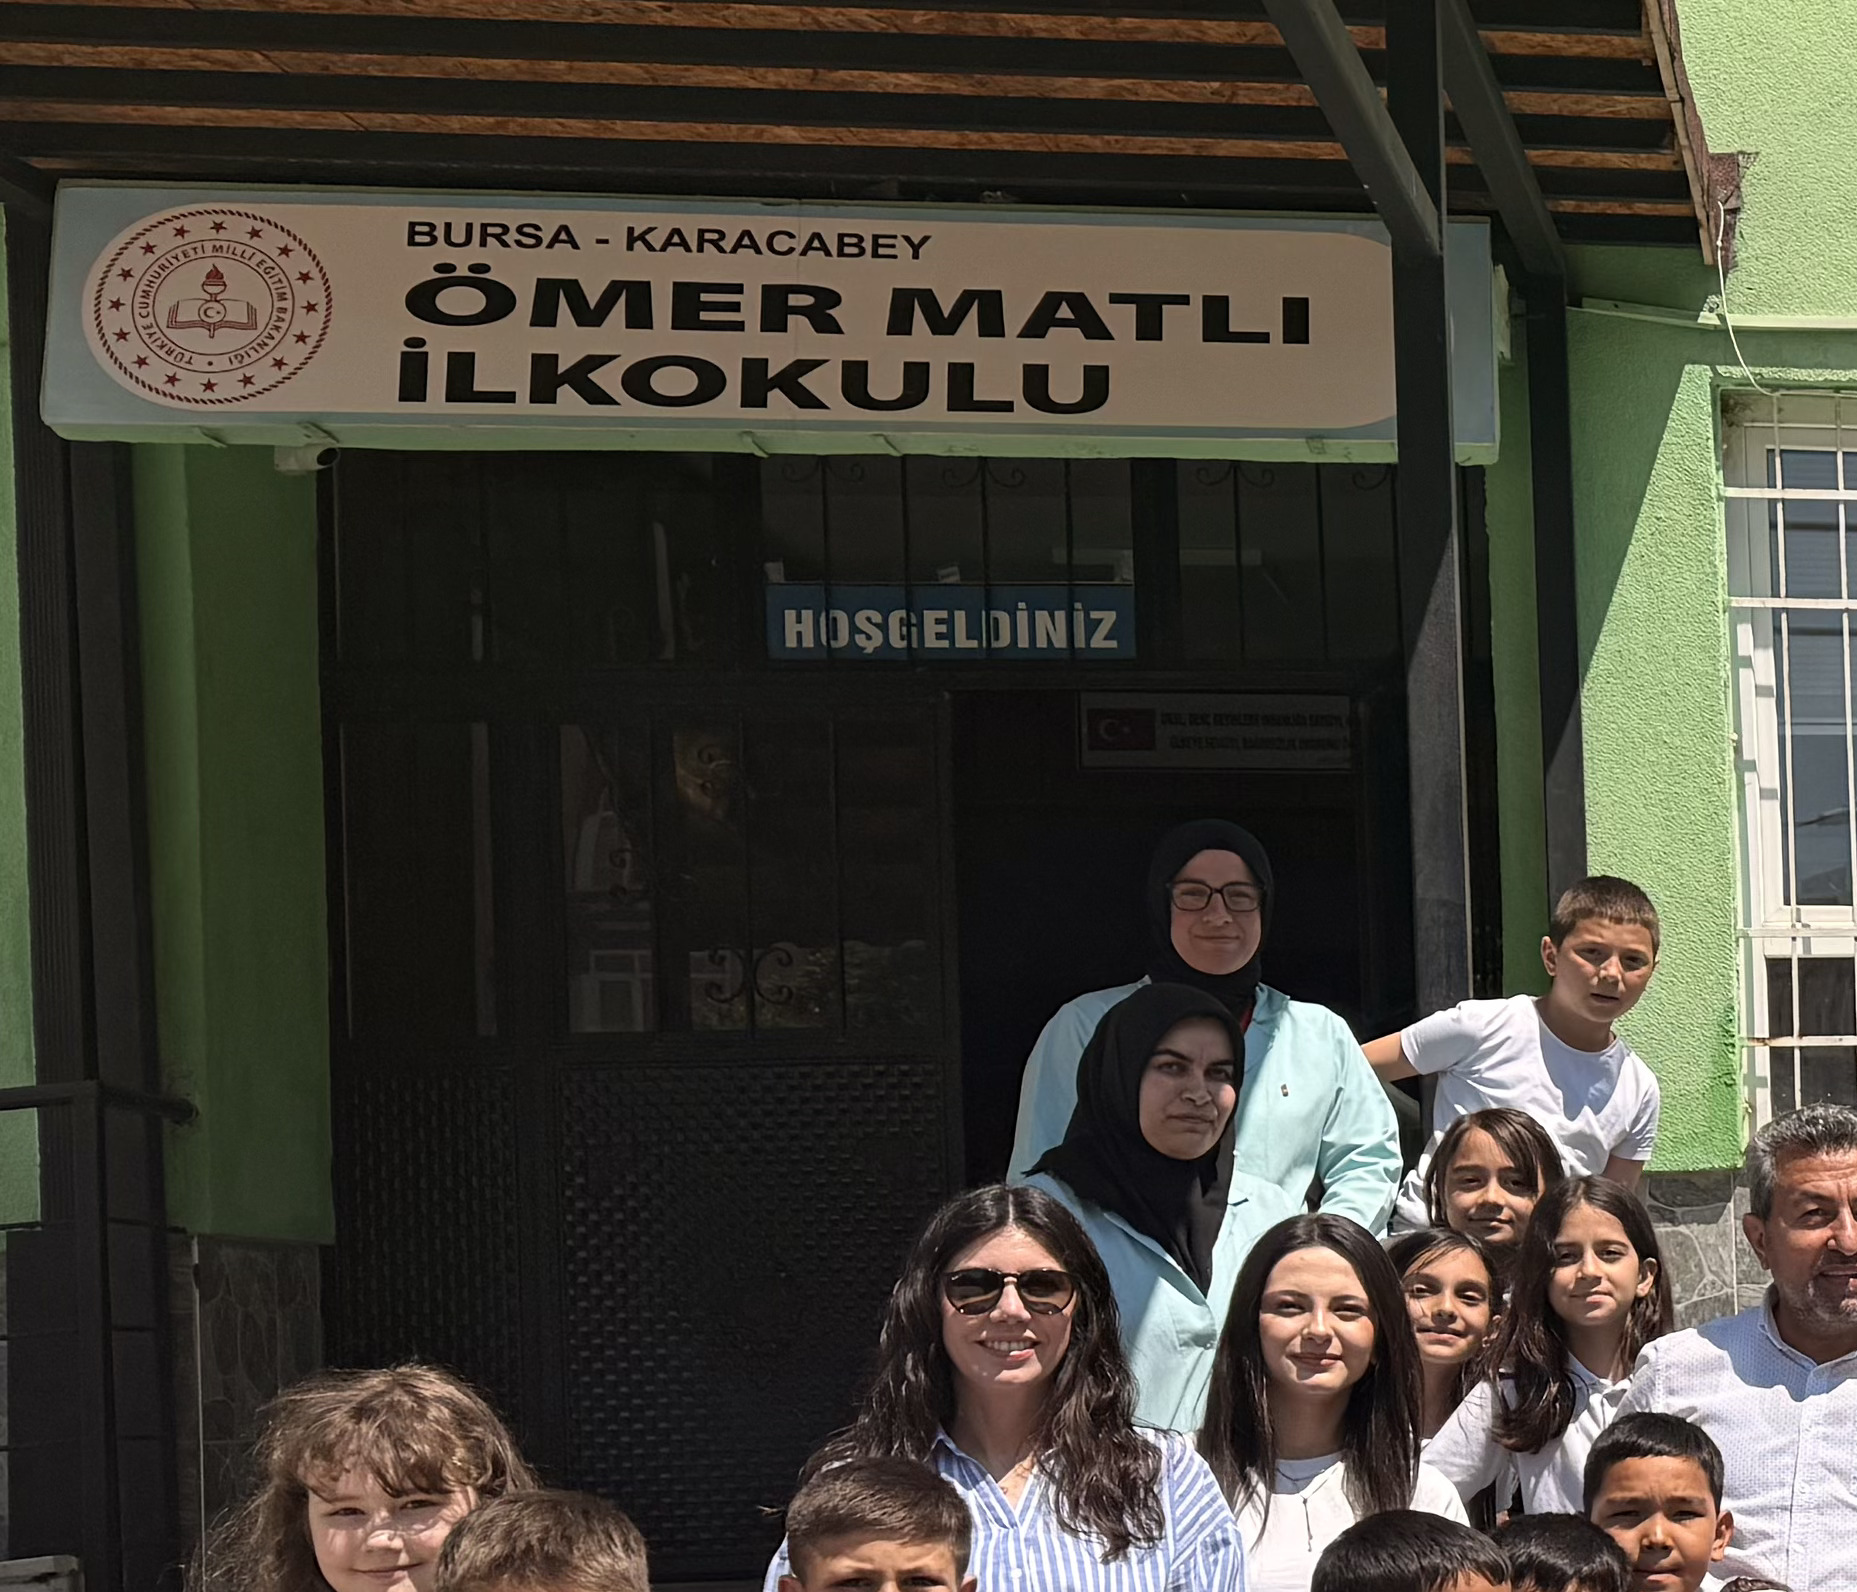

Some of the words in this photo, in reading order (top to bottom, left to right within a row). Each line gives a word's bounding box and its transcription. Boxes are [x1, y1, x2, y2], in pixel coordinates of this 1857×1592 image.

[406, 220, 581, 250] BURSA
[626, 226, 932, 260] KARACABEY
[138, 244, 206, 318] CUMHURİYETİ
[404, 262, 845, 335] ÖMER
[886, 287, 1309, 345] MATLI
[140, 322, 194, 366] TÜRKİYE
[228, 307, 288, 366] BAKANLIĞI
[399, 336, 1110, 414] İLKOKULU
[783, 602, 1118, 653] HOŞGELDİNİZ
